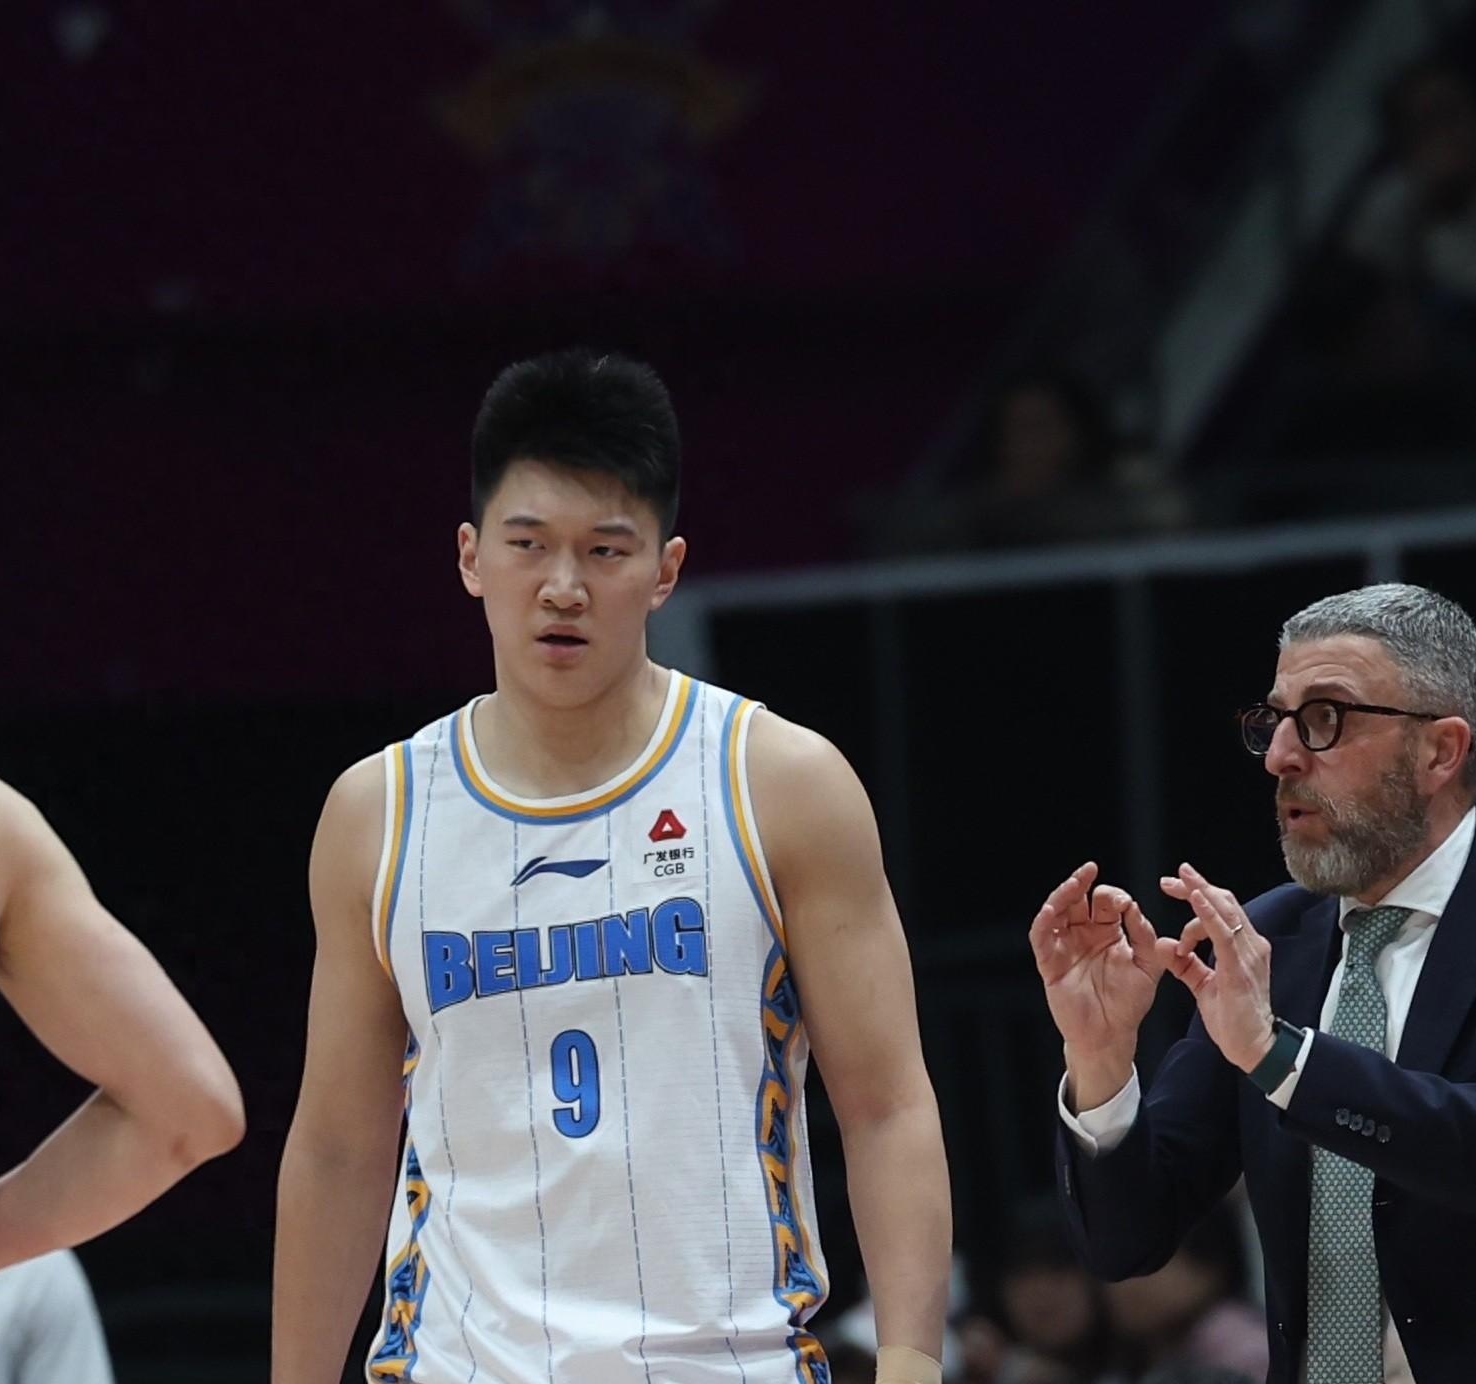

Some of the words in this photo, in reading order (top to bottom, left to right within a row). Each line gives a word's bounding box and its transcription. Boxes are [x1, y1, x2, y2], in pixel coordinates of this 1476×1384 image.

[643, 847, 695, 865] 广发银行
[654, 862, 685, 878] CGB
[423, 897, 709, 1015] BEIJING
[550, 1028, 601, 1139] 9
